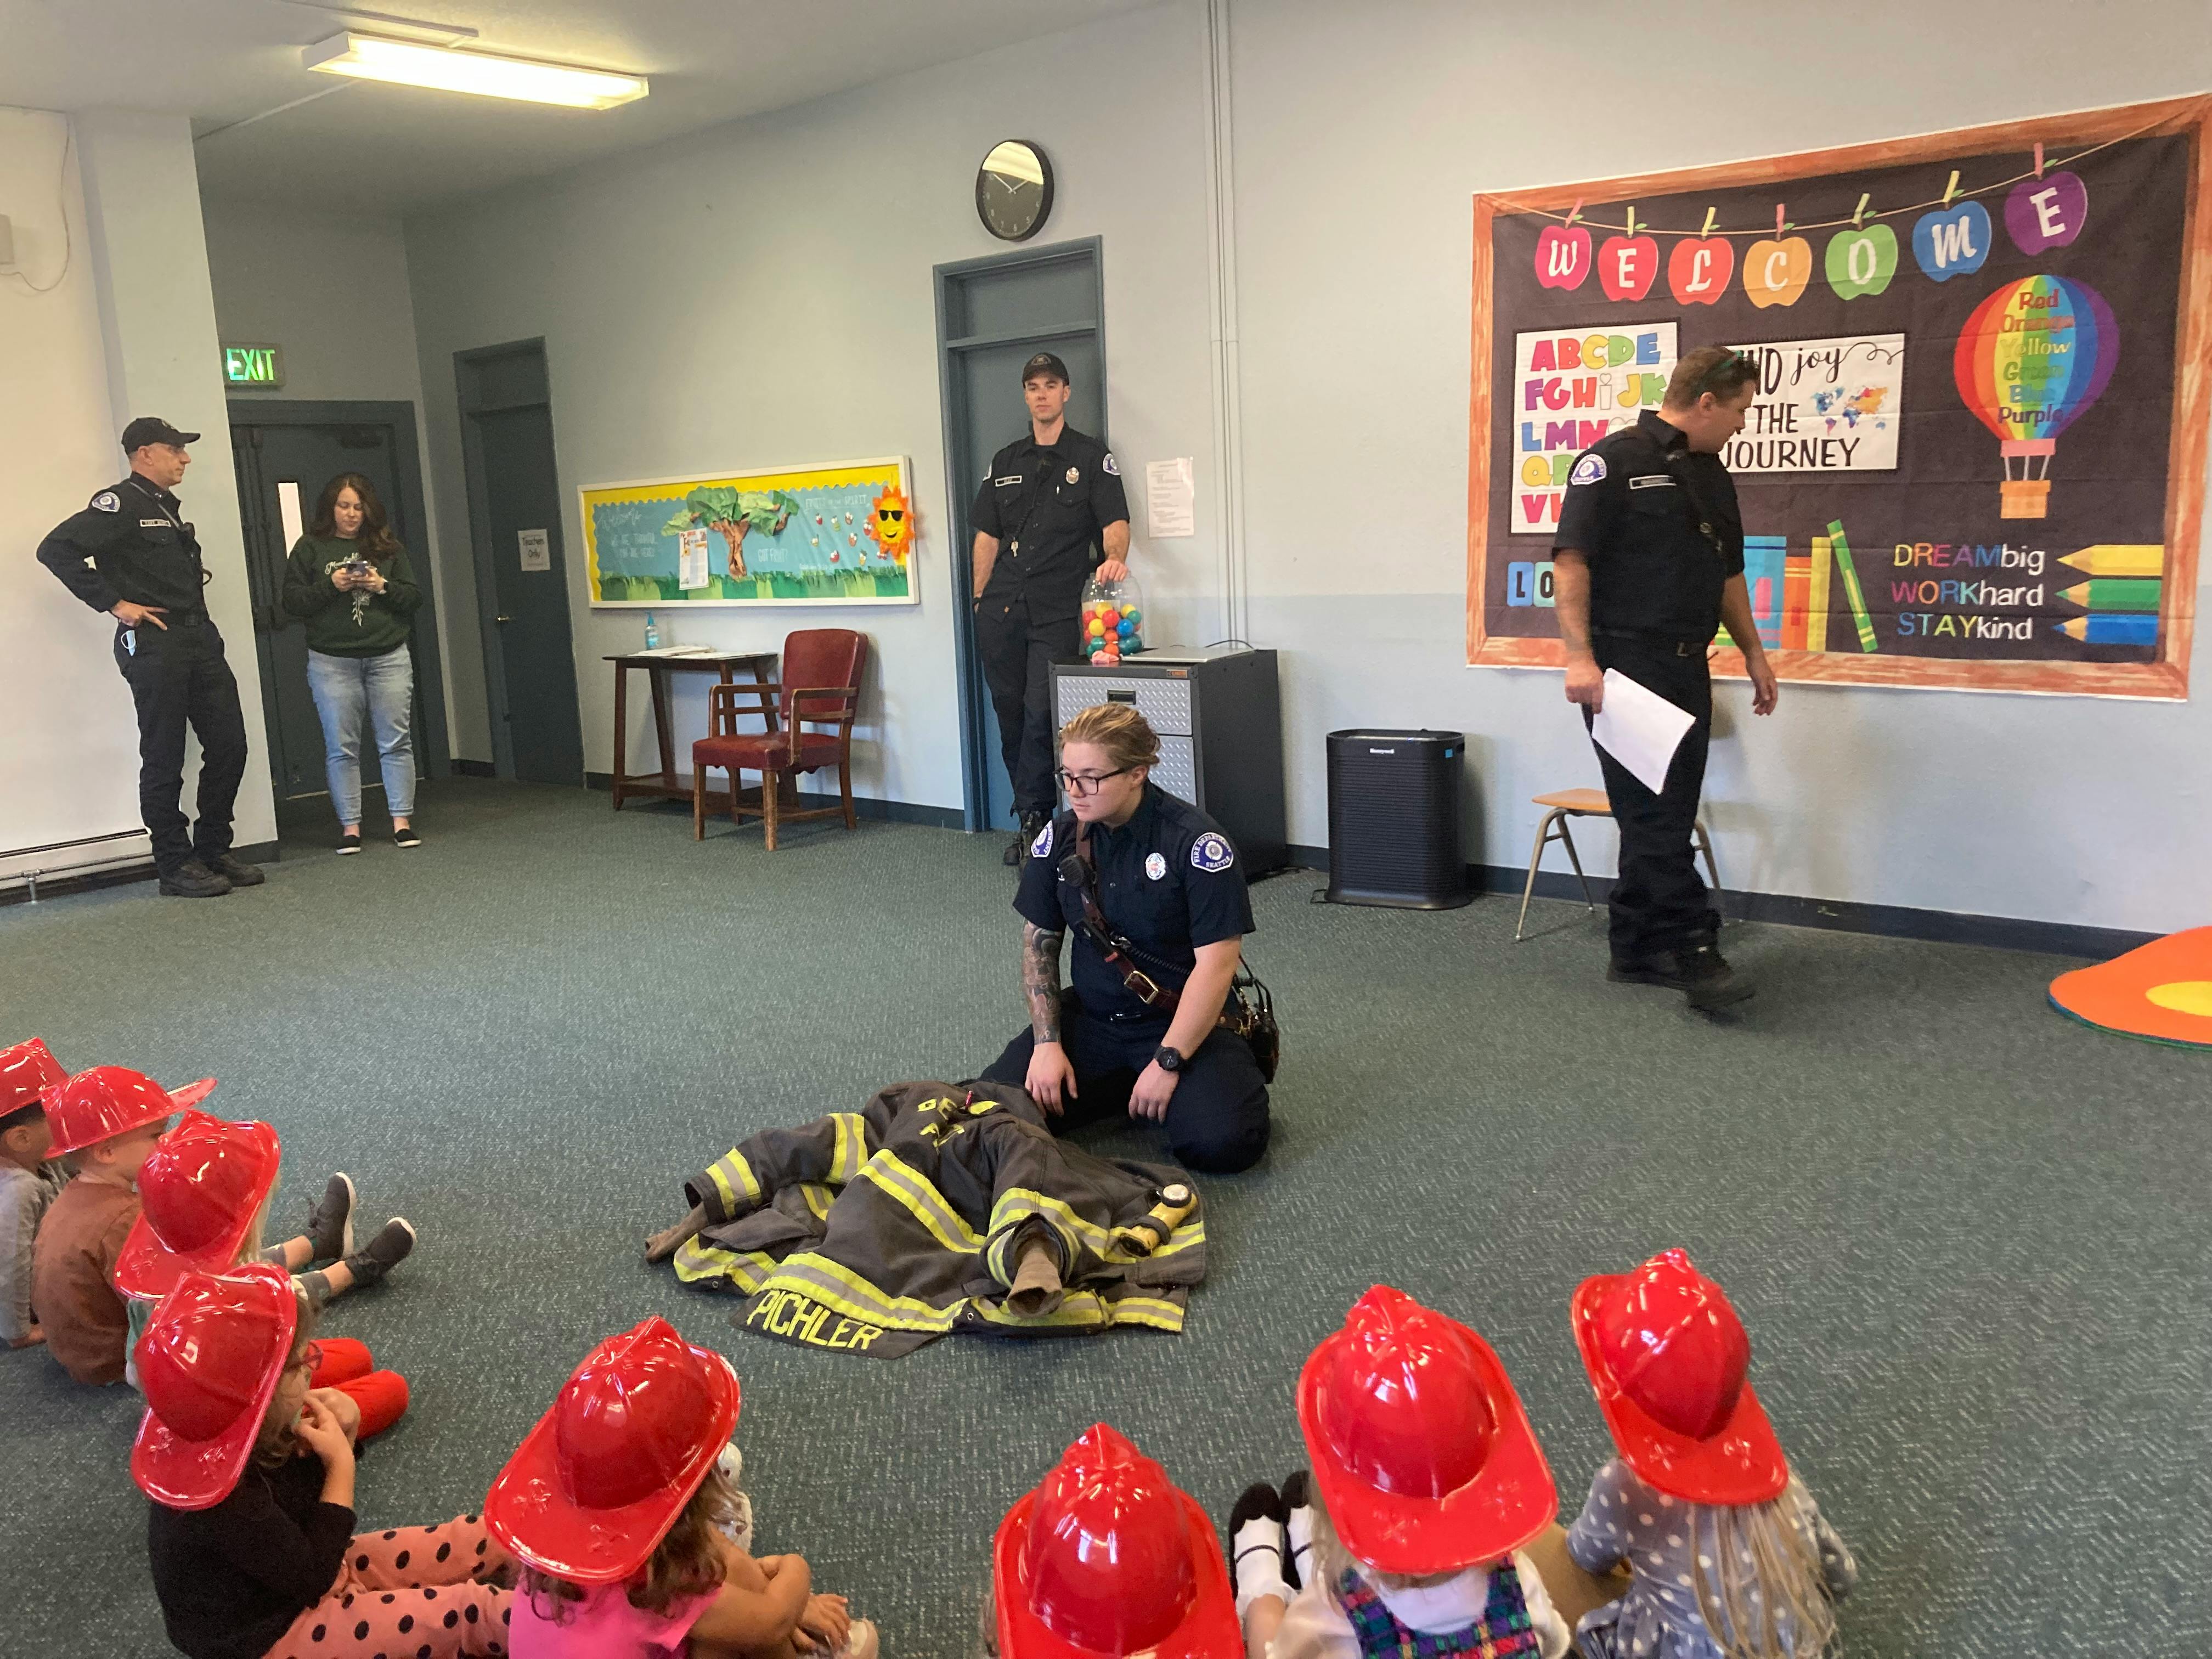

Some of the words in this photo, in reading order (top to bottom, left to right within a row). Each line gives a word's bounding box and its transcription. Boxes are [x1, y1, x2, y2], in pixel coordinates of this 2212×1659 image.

[1548, 187, 2066, 293] WELCOME
[2019, 289, 2059, 309] Red
[1531, 332, 1661, 371] ABCDE
[2000, 338, 2072, 357] Yellow
[226, 348, 275, 381] EXIT
[1741, 346, 1782, 396] ND
[1791, 345, 1853, 386] joy
[1752, 402, 1799, 434] THE
[1998, 404, 2063, 427] Purple
[1727, 437, 1860, 469] JOURNEY
[1516, 570, 1554, 599] LO
[747, 1290, 884, 1350] PICHLER
